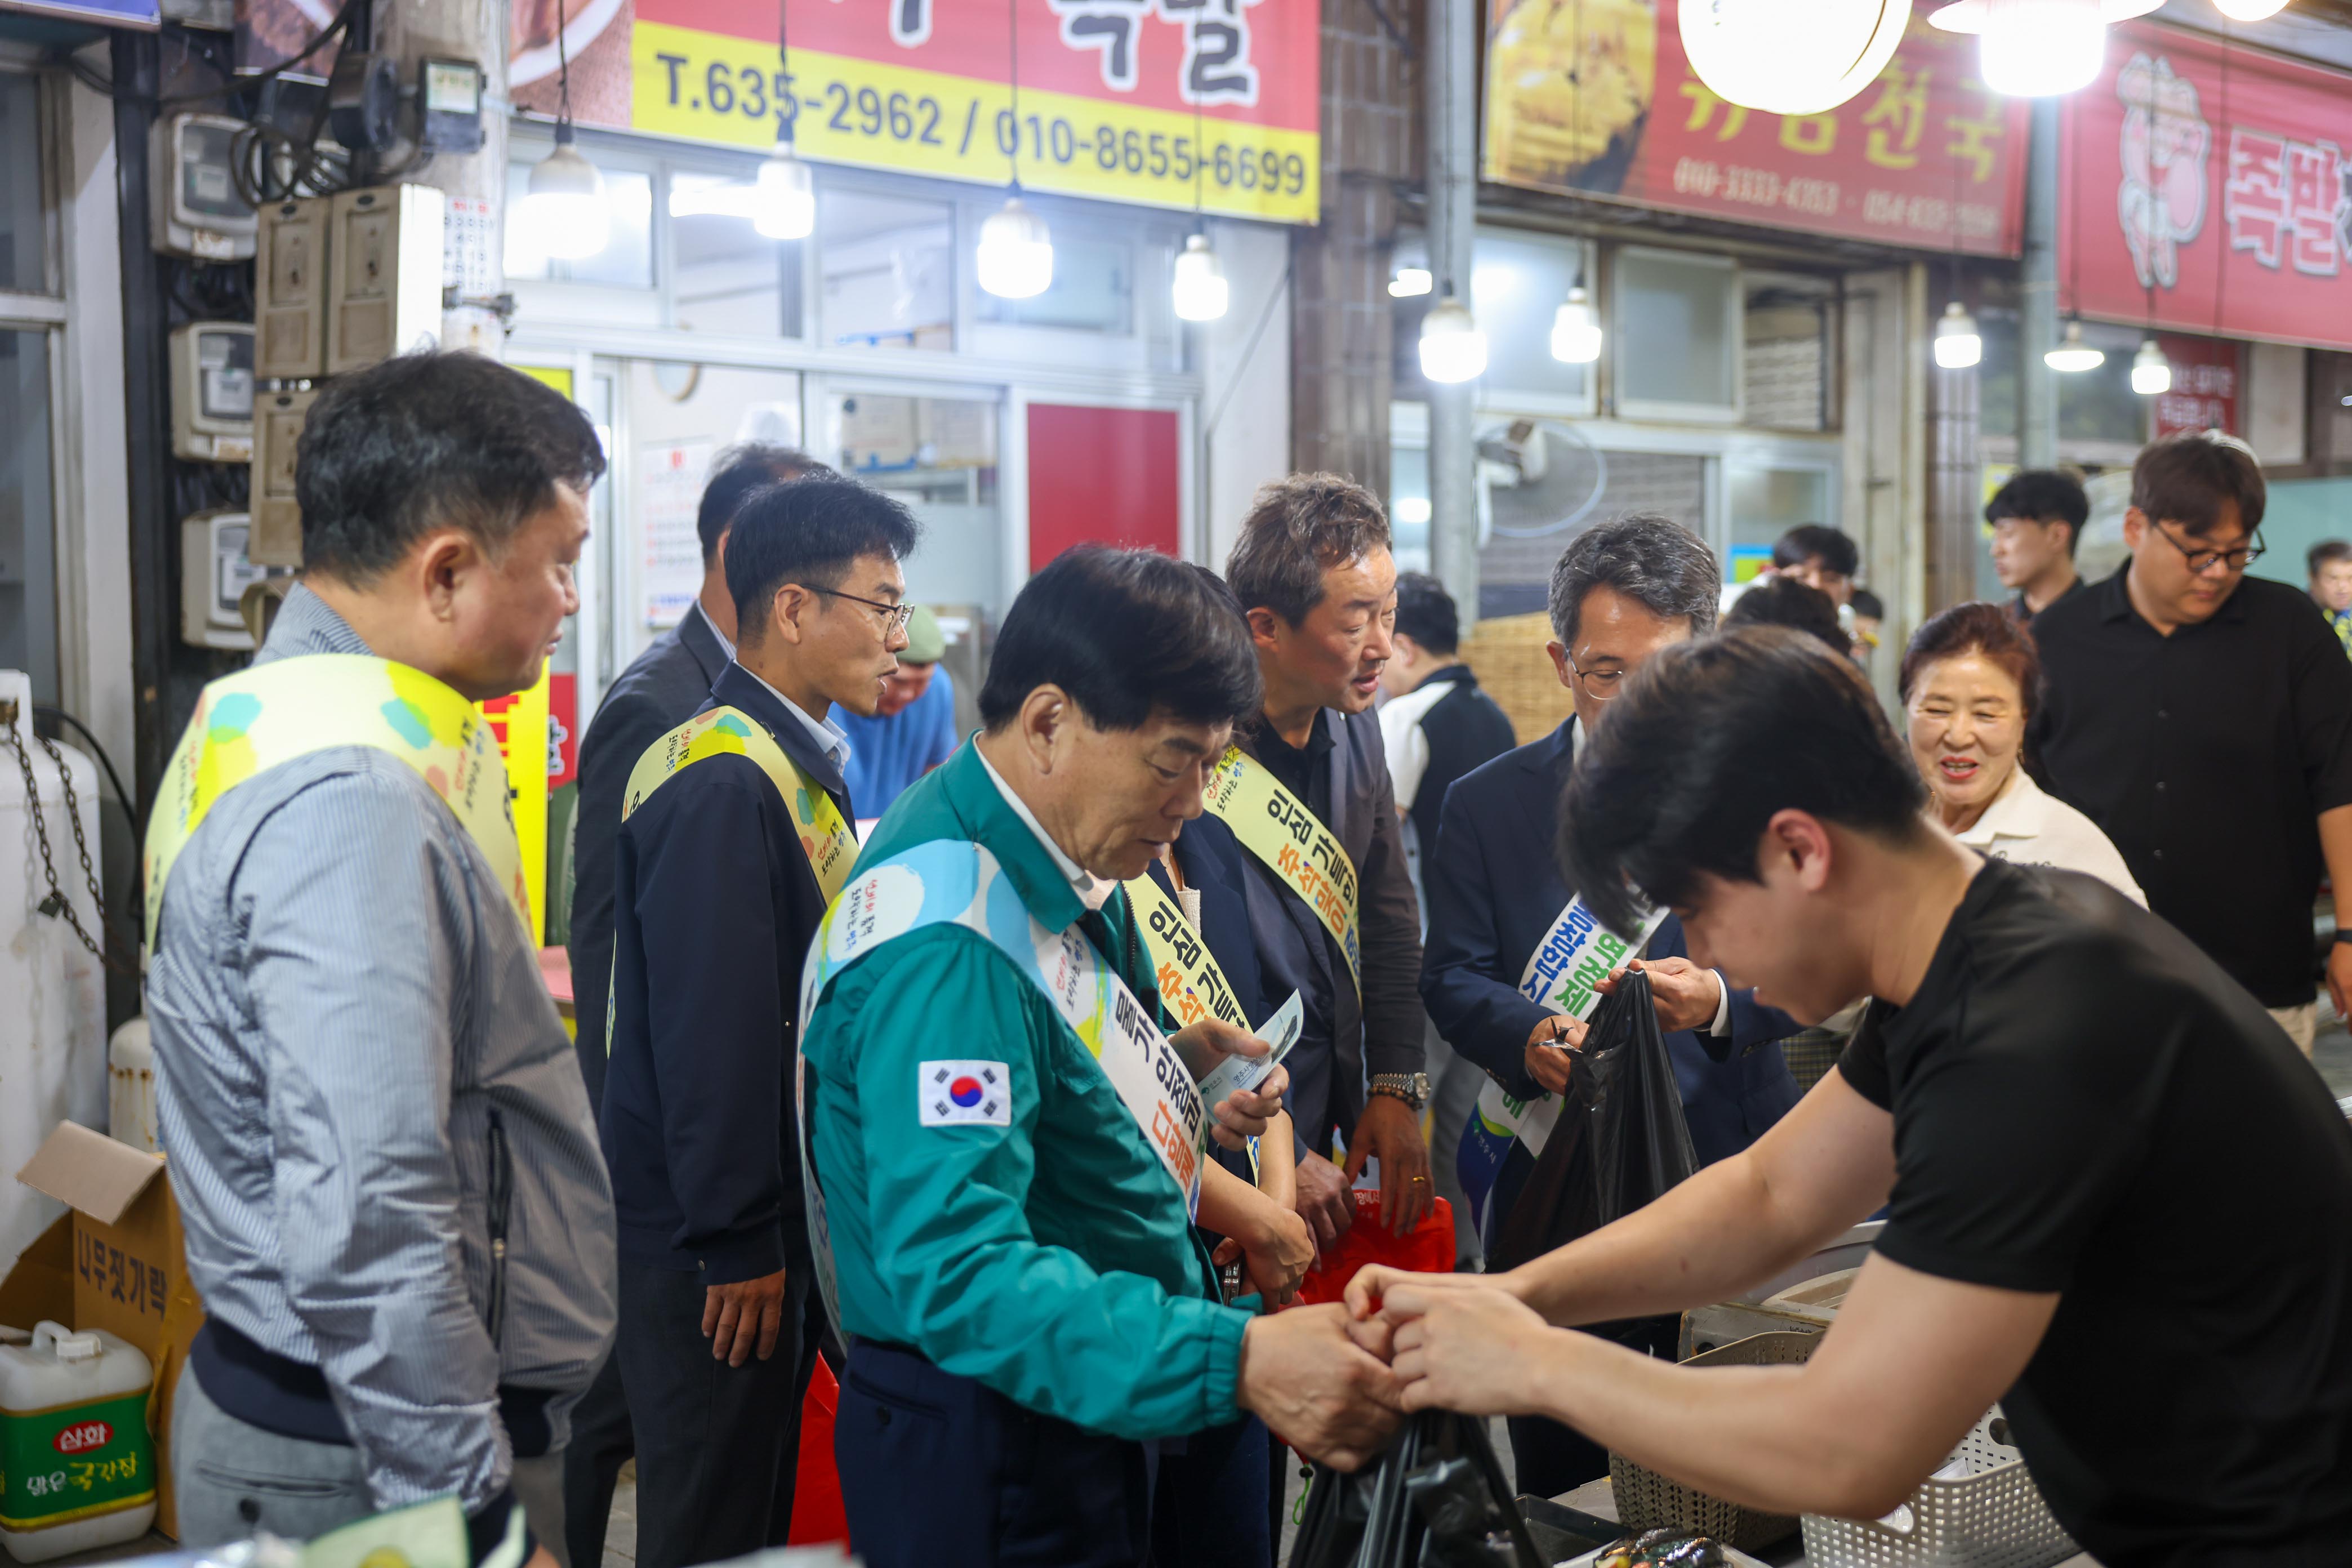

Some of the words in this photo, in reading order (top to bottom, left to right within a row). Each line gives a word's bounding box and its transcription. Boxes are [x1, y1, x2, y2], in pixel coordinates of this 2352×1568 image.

[655, 51, 942, 145] T.635-2962
[996, 108, 1305, 195] 010-8655-6699
[2226, 126, 2339, 276] 족발
[1267, 789, 1313, 845] 인심
[1312, 833, 1356, 908] 가득한
[1278, 843, 1348, 935] 추석맞이
[1149, 901, 1202, 970] 인심
[1197, 963, 1246, 1030] 가득
[1156, 961, 1212, 1025] 추석
[1522, 898, 1598, 1005] 동참합시
[1554, 921, 1646, 1017] 역경제
[1115, 989, 1155, 1063] 물가
[1156, 1043, 1201, 1142] 안정과
[1152, 1099, 1195, 1195] 다함께
[78, 1228, 168, 1320] 나무젓가락
[59, 1423, 107, 1451] 삼화
[69, 1451, 137, 1491] 국간장
